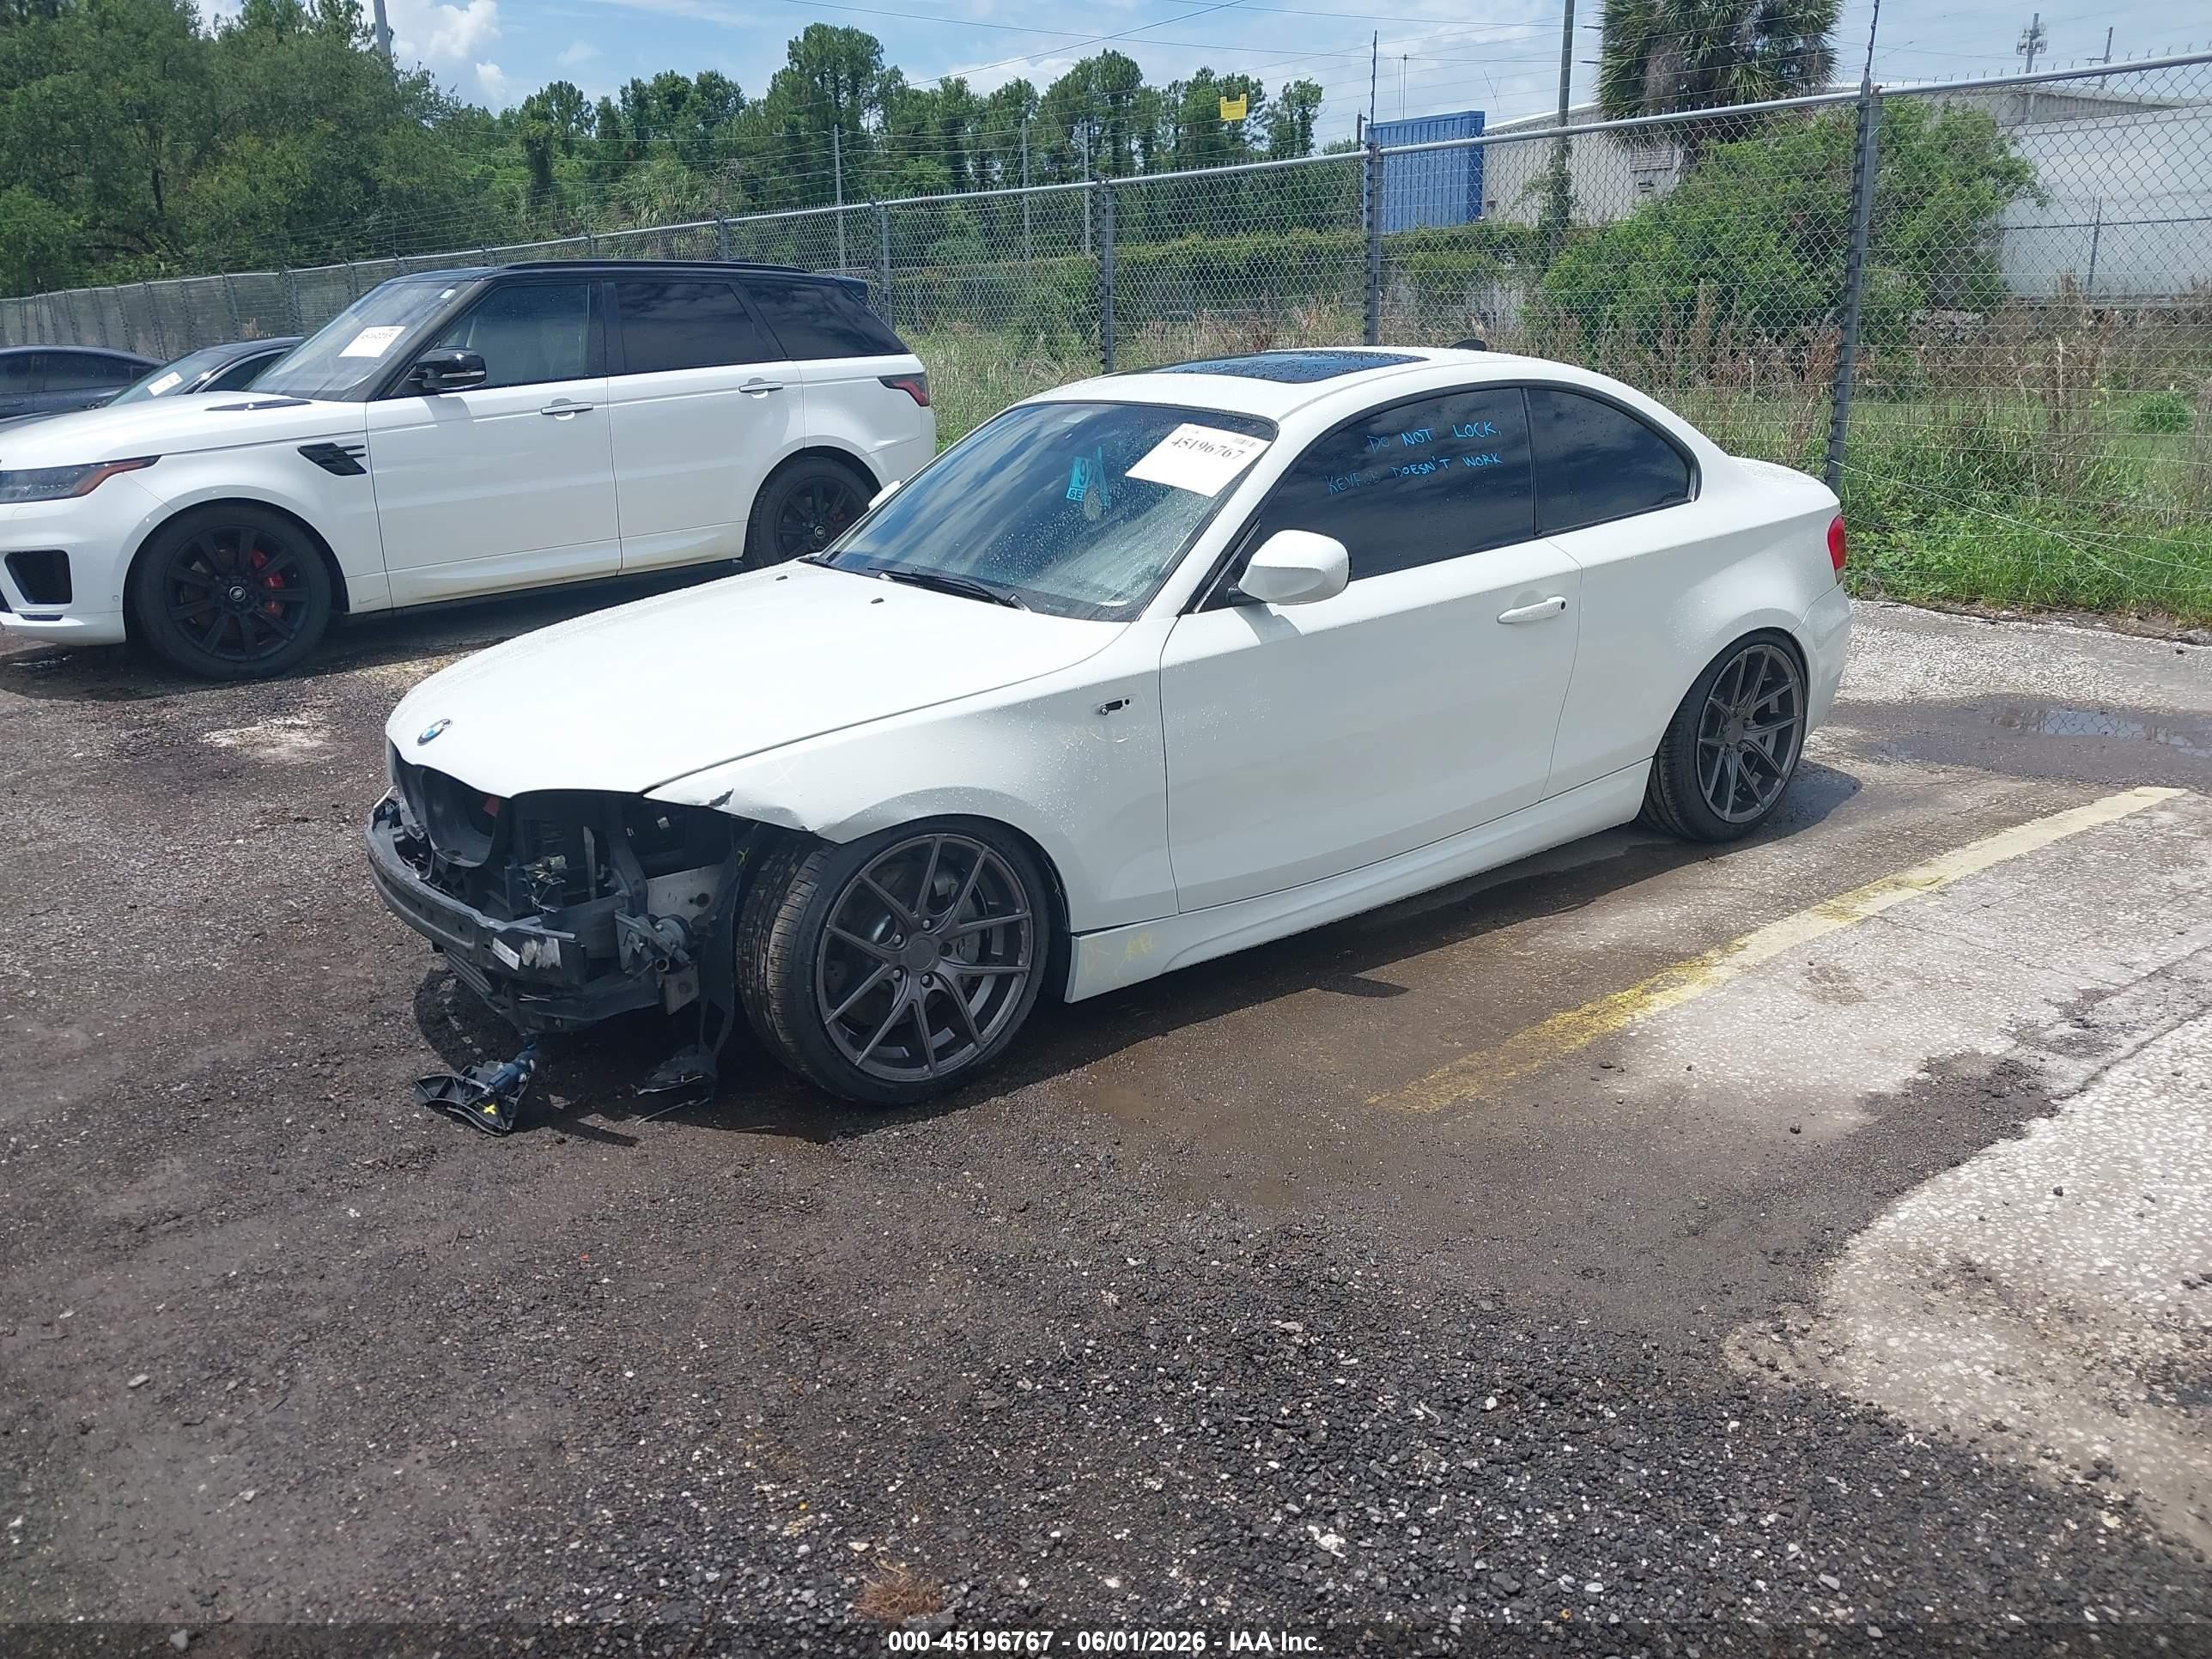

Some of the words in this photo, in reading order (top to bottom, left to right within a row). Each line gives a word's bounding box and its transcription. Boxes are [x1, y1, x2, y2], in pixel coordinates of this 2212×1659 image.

[1171, 437, 1247, 460] 45196767
[1367, 436, 1390, 453] DO
[1401, 428, 1435, 447] NOT
[1391, 455, 1451, 478] DOESN'T
[1462, 453, 1504, 467] WORK
